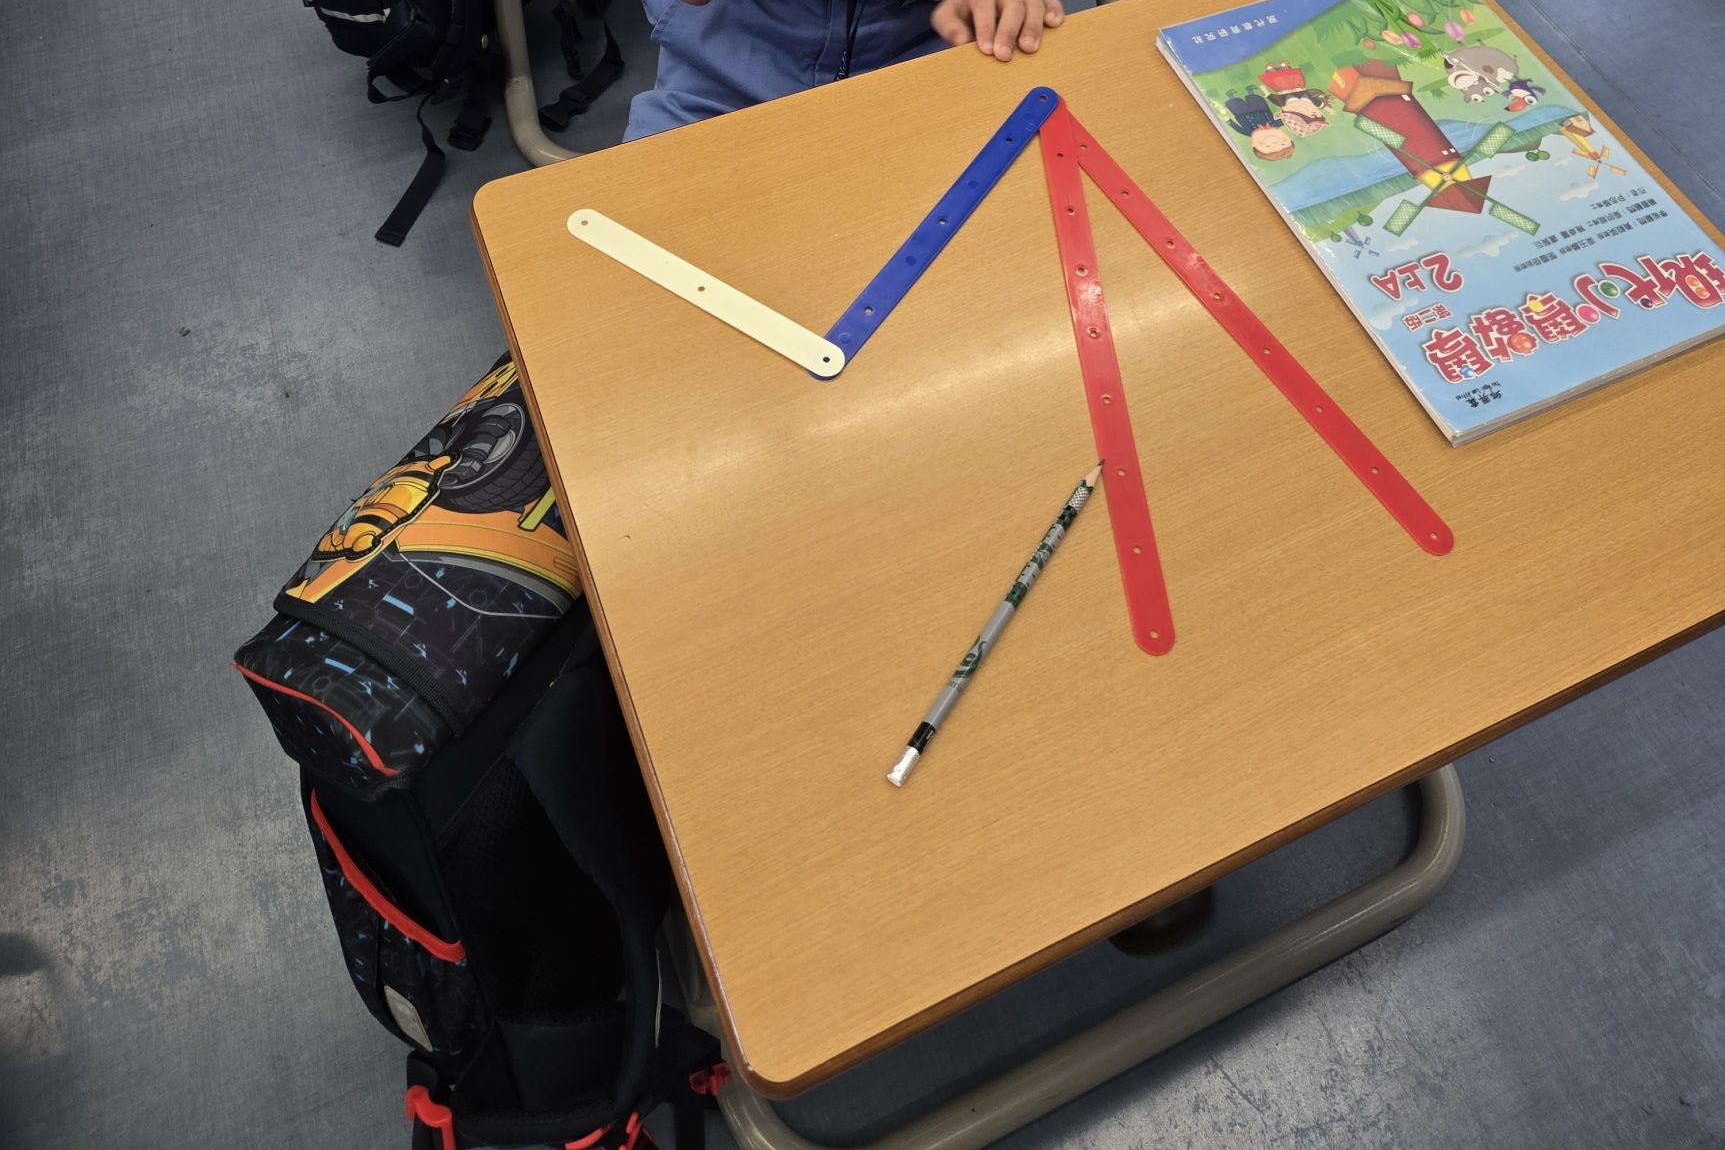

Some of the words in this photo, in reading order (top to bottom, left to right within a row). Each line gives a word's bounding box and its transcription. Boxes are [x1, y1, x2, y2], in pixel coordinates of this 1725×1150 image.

[1191, 15, 1278, 44] 現代教育研究社
[1370, 251, 1464, 301] 2上A
[1402, 302, 1454, 333] 第二版
[1422, 250, 1725, 384] 現代小學數學
